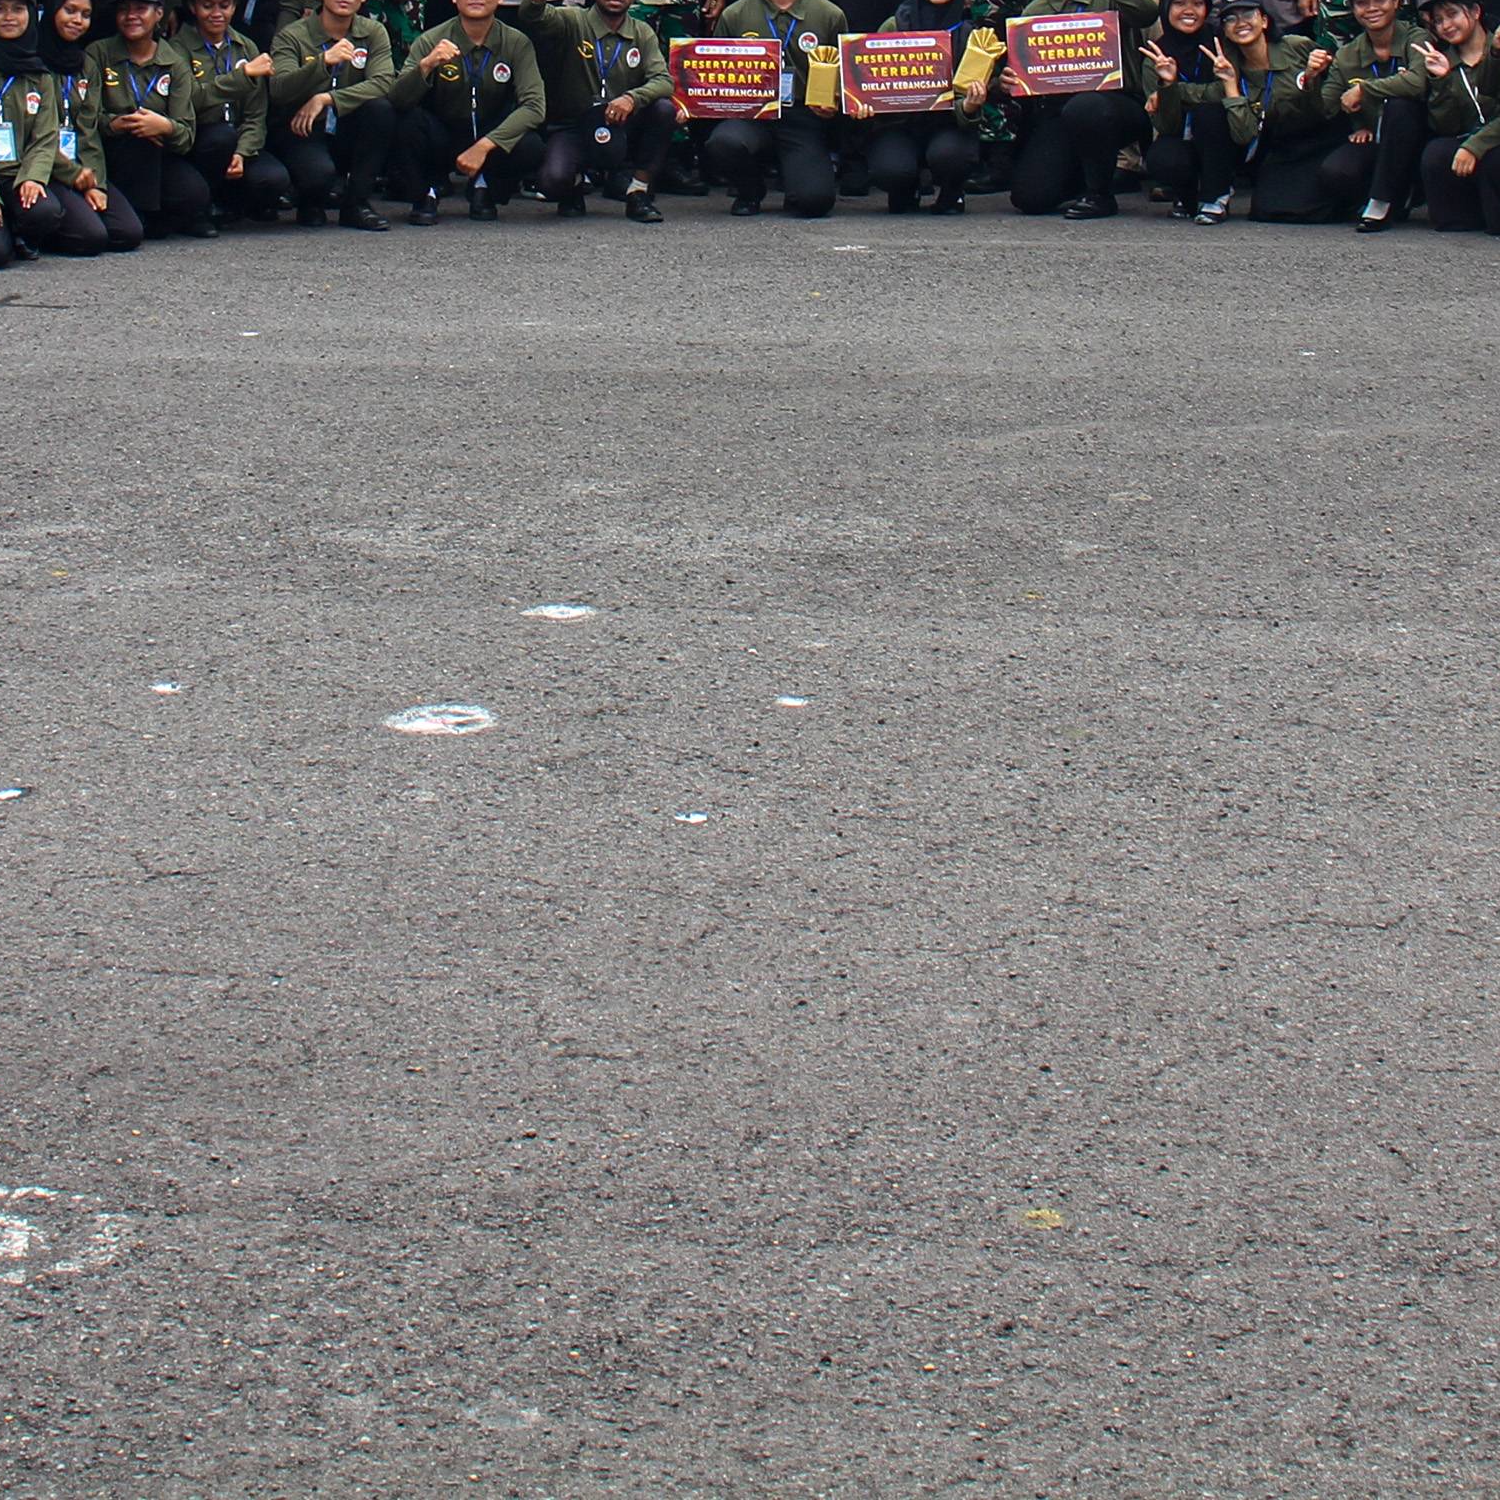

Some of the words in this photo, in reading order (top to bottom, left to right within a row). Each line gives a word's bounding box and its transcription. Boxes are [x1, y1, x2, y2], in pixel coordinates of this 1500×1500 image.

[1027, 31, 1108, 47] KELOMPOK
[854, 53, 907, 65] PESERTA
[908, 52, 944, 62] PUTRI
[1038, 46, 1102, 60] TERBAIK
[683, 60, 734, 69] PESERTA
[737, 60, 776, 70] PUTRA
[870, 65, 935, 77] TERBAIK
[1027, 64, 1057, 75] DIKLAT
[1058, 60, 1114, 72] KEBANGSAAN
[698, 73, 763, 84] TERBAIK
[861, 81, 891, 92] DIKLAT
[892, 79, 949, 90] KEBANGSAAN
[687, 88, 718, 97] DIKLAT
[718, 88, 775, 98] KEBANGSAAN
